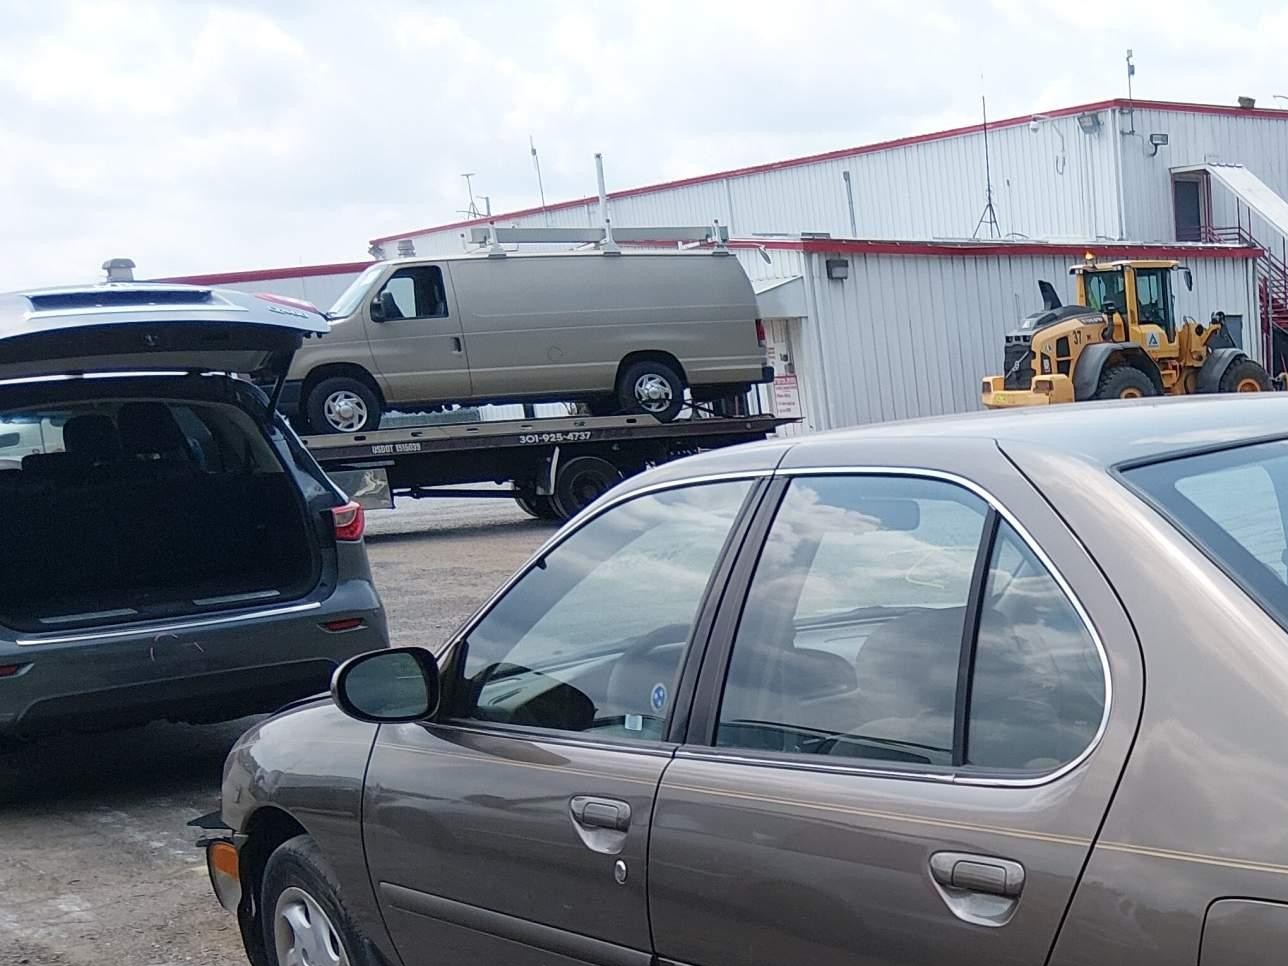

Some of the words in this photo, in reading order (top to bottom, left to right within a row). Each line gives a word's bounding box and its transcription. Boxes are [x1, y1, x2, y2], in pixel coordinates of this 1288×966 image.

[1073, 329, 1081, 344] 37
[519, 431, 591, 444] 301-925-4737
[371, 445, 393, 454] USDOT
